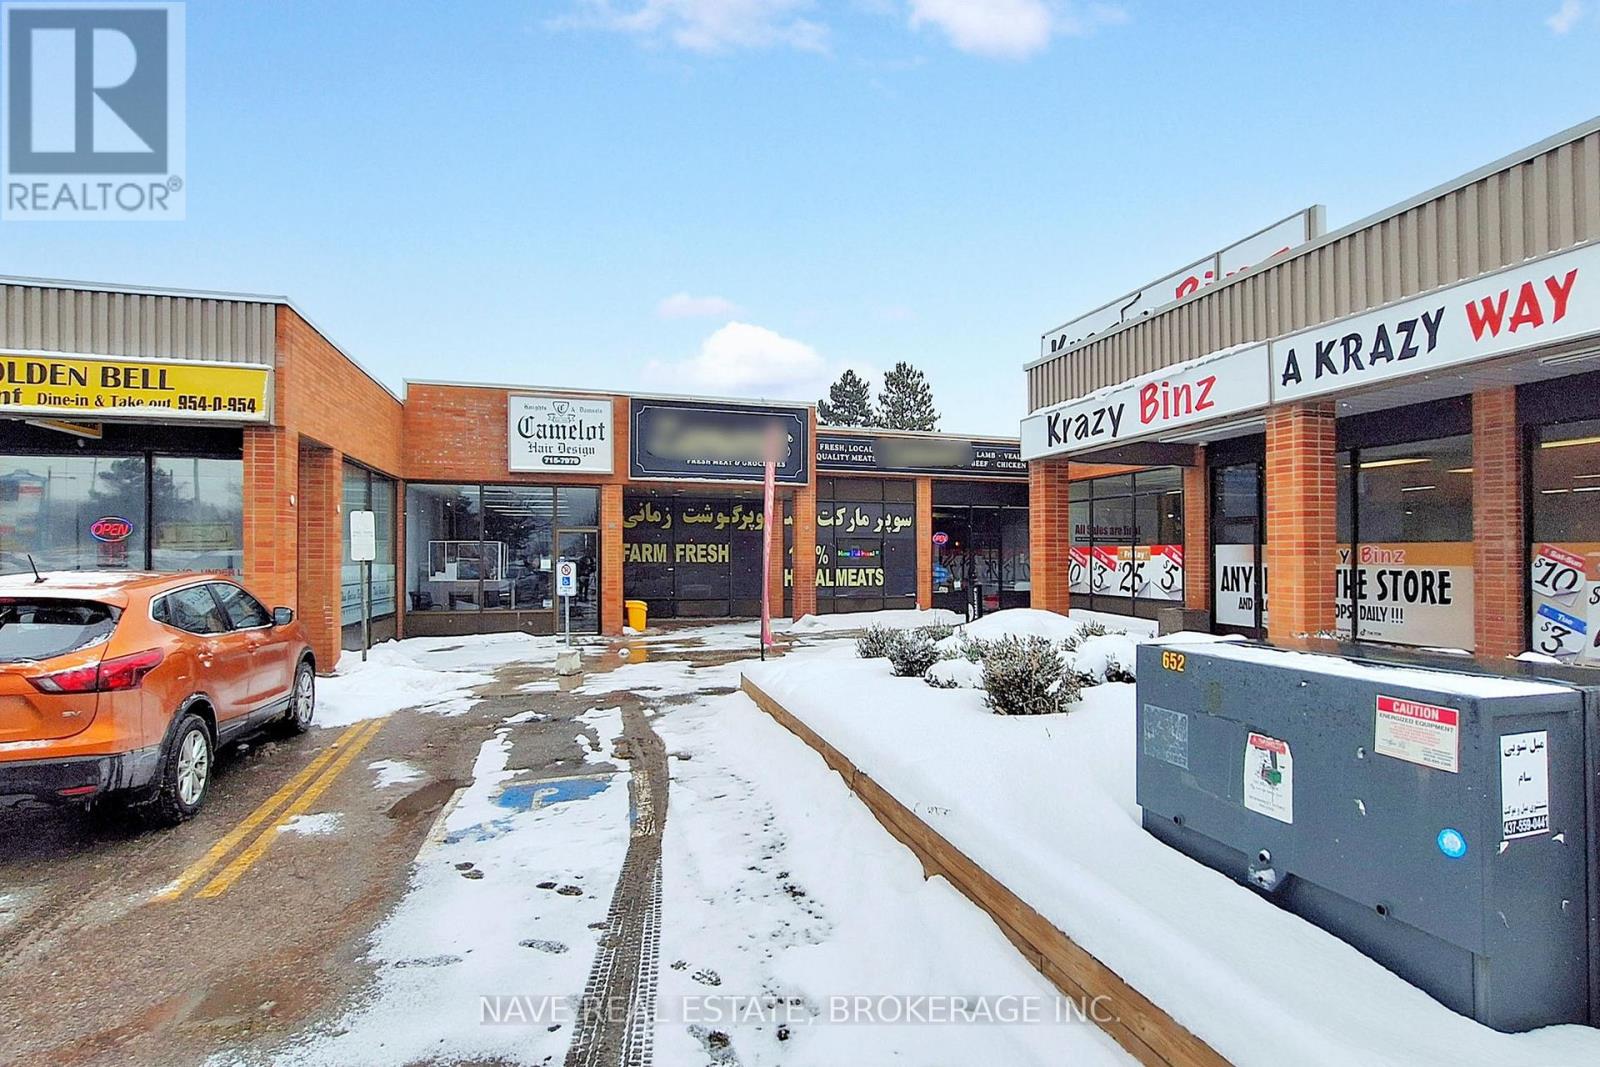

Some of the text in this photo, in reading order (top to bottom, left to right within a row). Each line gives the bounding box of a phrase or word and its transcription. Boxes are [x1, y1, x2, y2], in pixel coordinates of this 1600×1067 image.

[1282, 267, 1579, 387] A KRAZY WAY
[0, 361, 175, 391] LDEN BELL
[37, 392, 89, 407] Dine-in
[94, 394, 104, 407] &
[110, 394, 144, 408] Take
[1047, 374, 1216, 447] Krazy Binz
[517, 415, 606, 441] Camelot
[528, 441, 595, 457] Hair Design
[816, 453, 850, 461] QUALITY
[819, 443, 847, 453] FRESH,
[976, 451, 996, 459] LAMB
[94, 523, 129, 536] OPEN
[873, 508, 913, 533] سوپر
[1075, 524, 1086, 535] All
[623, 543, 729, 563] FARM FRESH
[1123, 550, 1145, 560] Friay
[1360, 546, 1406, 564] Binz
[835, 568, 885, 587] MEATS
[1161, 560, 1180, 590] $5
[1221, 565, 1253, 592] ANY
[1335, 569, 1367, 599] THE
[1376, 569, 1452, 605] STORE
[1534, 558, 1578, 592] $10
[1238, 596, 1253, 610] AND
[1359, 604, 1388, 623] DAILY
[1540, 621, 1571, 654] $3
[1162, 651, 1185, 672] 652
[1392, 701, 1439, 720] CAUTION
[1379, 713, 1454, 733] ENERGIZED EQUIPMENT
